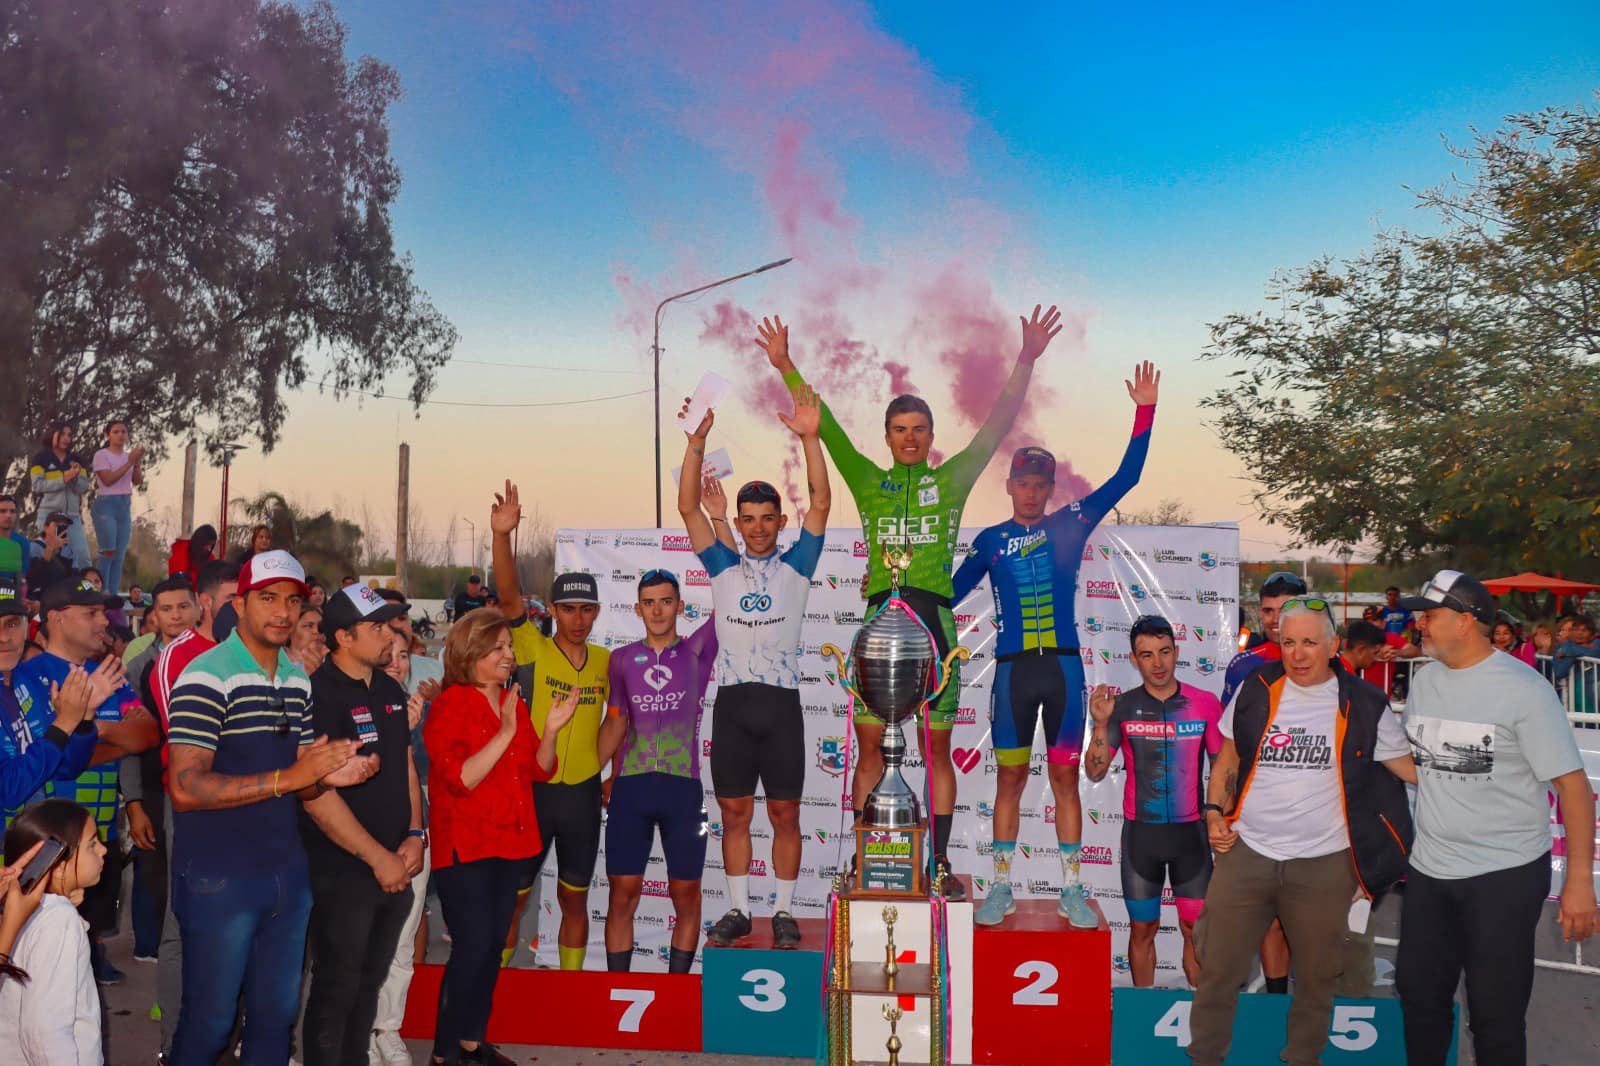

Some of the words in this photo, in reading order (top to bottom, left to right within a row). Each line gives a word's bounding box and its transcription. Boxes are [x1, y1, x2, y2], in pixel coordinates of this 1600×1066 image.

[727, 616, 752, 628] Cycling
[754, 616, 786, 626] Trainer
[631, 691, 686, 704] GODOY
[640, 703, 679, 712] CRUZ
[1126, 724, 1174, 733] DORITA
[1178, 723, 1205, 733] LUIS
[1291, 735, 1327, 746] VUELTA
[1259, 746, 1332, 764] ICLISTICA
[865, 843, 910, 854] CICLISTICA
[1081, 846, 1112, 855] ORITA
[1012, 960, 1060, 1006] 2
[738, 968, 788, 1012] 3
[610, 988, 656, 1032] 7
[1154, 1000, 1193, 1047] 4
[1329, 1006, 1379, 1051] 5
